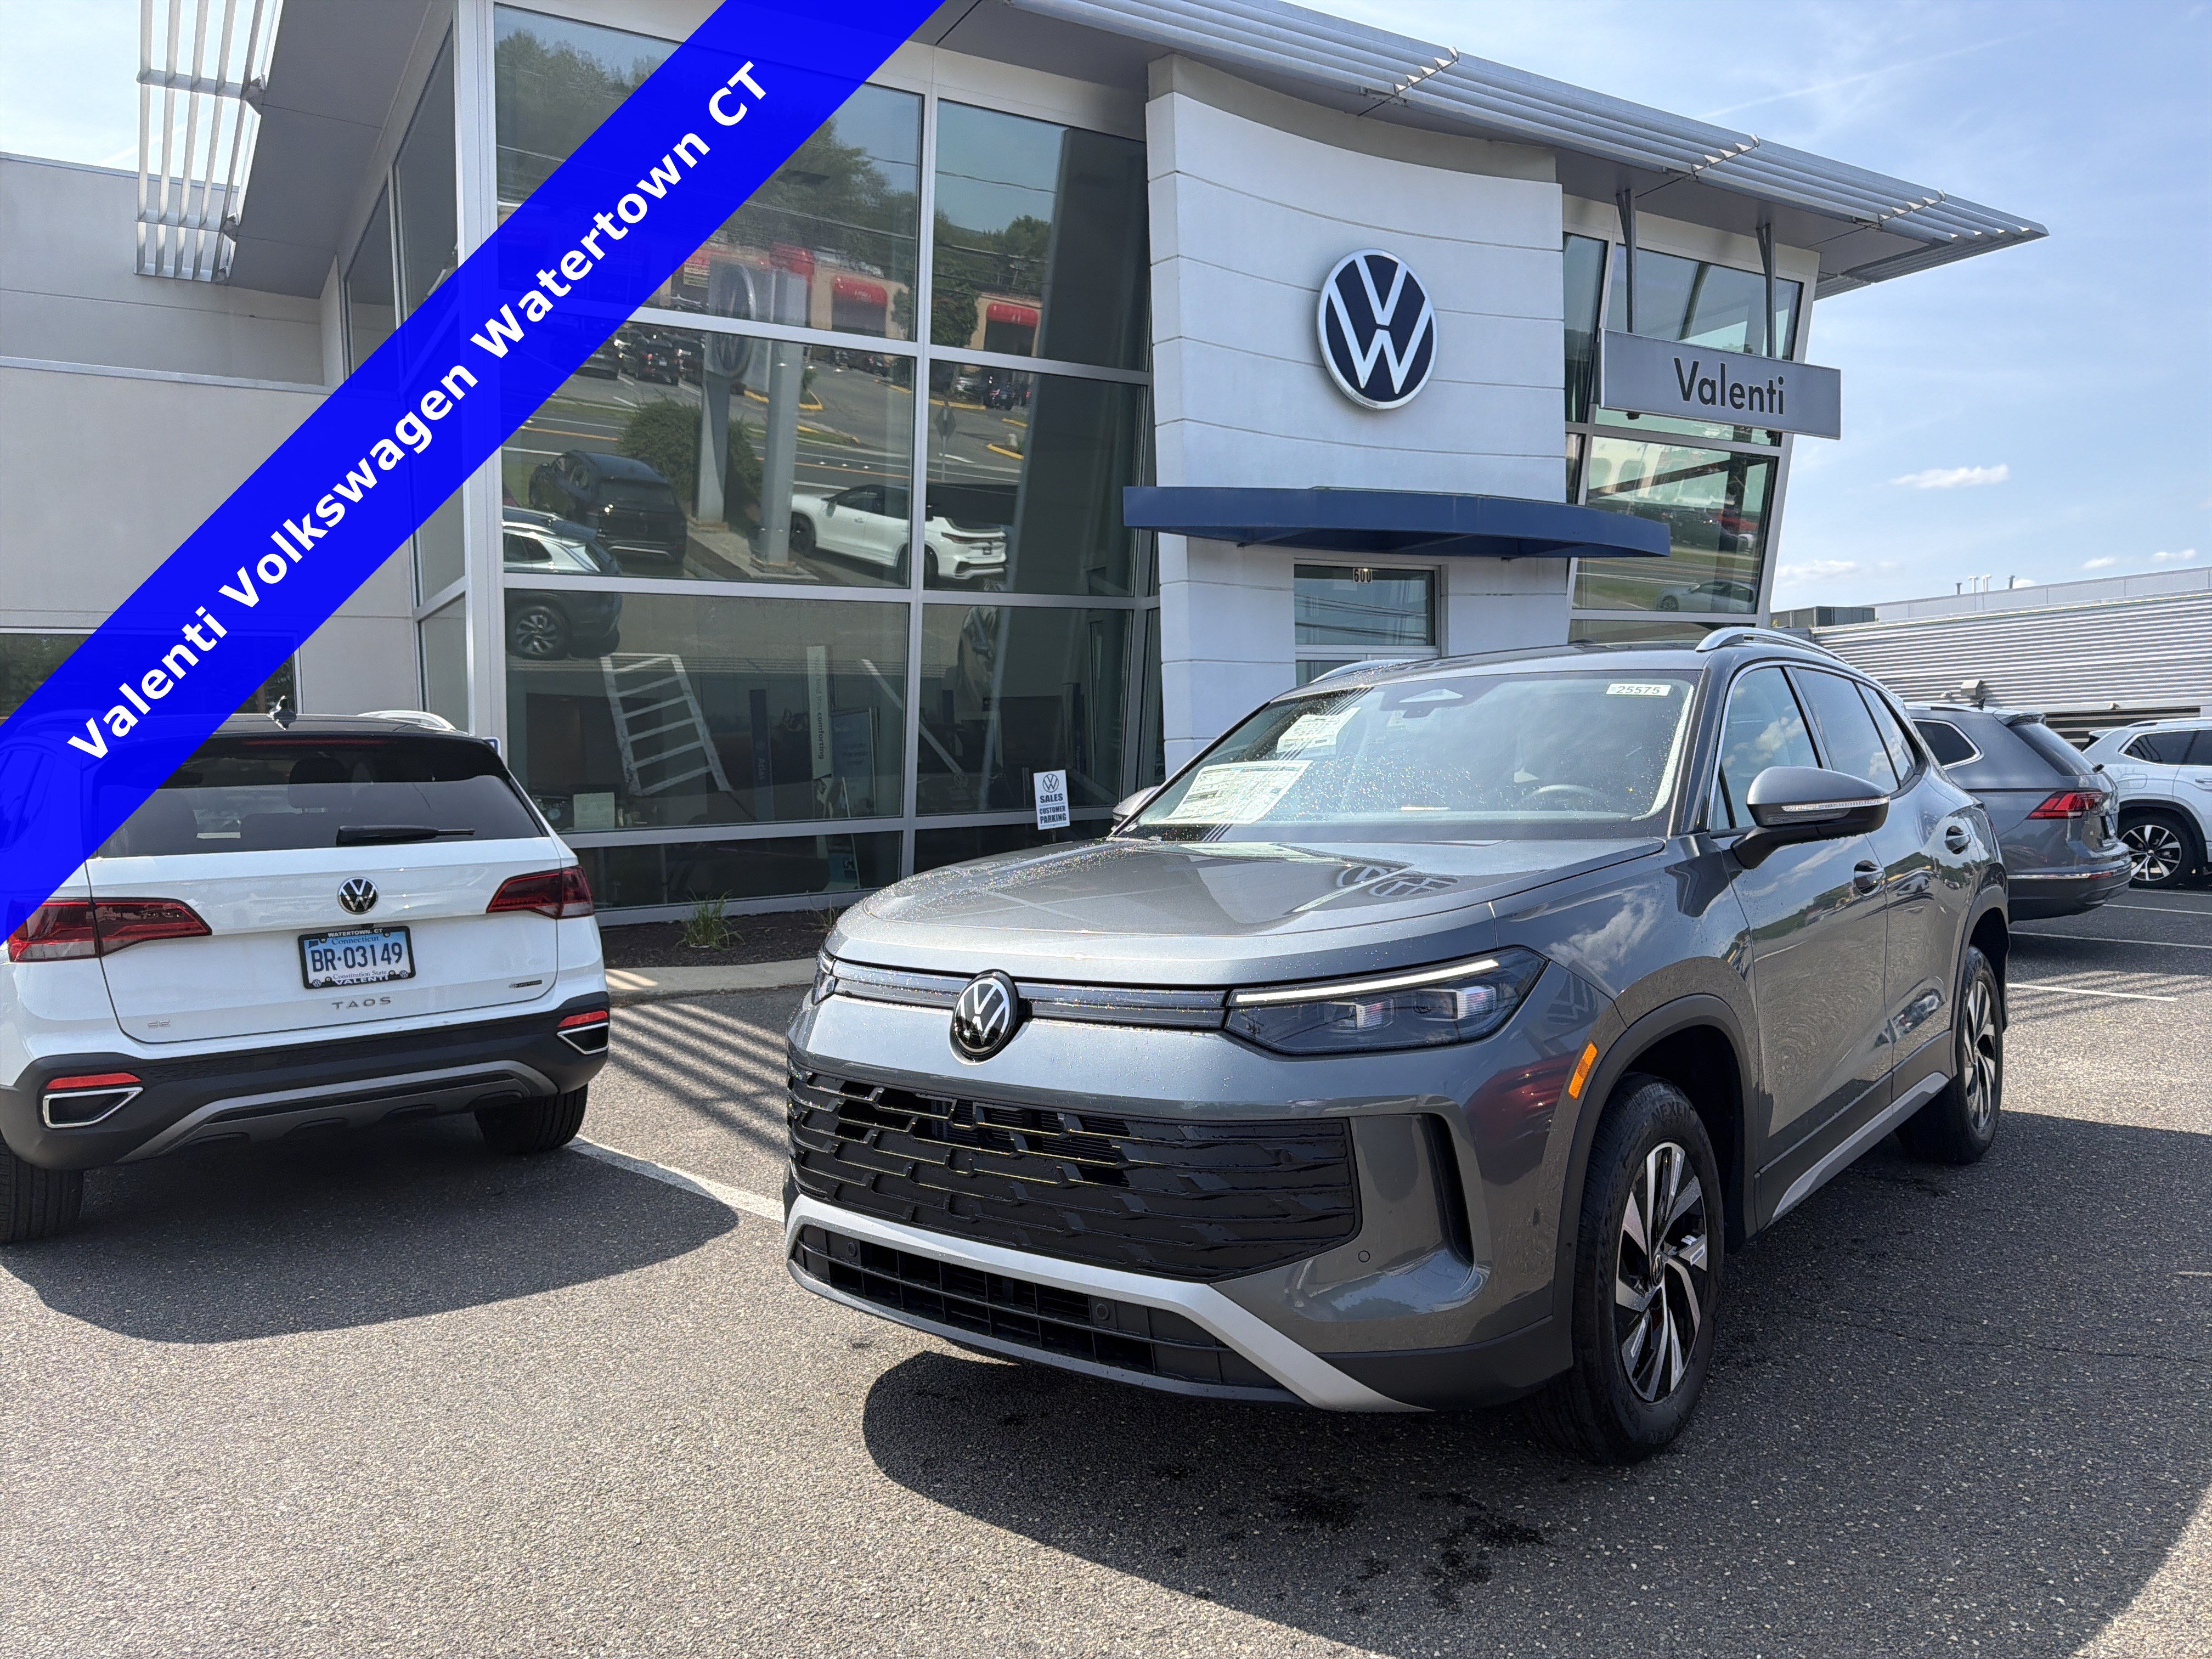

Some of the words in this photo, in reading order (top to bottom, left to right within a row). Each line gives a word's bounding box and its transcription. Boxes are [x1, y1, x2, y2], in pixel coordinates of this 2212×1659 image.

[1673, 357, 1784, 415] Valenti
[1354, 568, 1372, 583] 600
[1616, 686, 1661, 695] 25575
[1040, 793, 1063, 804] SALES
[1039, 805, 1066, 815] CUSTOMER
[1040, 813, 1067, 825] PARKING
[331, 935, 380, 945] Connecticut
[332, 971, 371, 980] Constitution
[335, 975, 389, 985] VALENTI
[331, 996, 392, 1010] TAOS
[148, 1020, 171, 1029] SE
